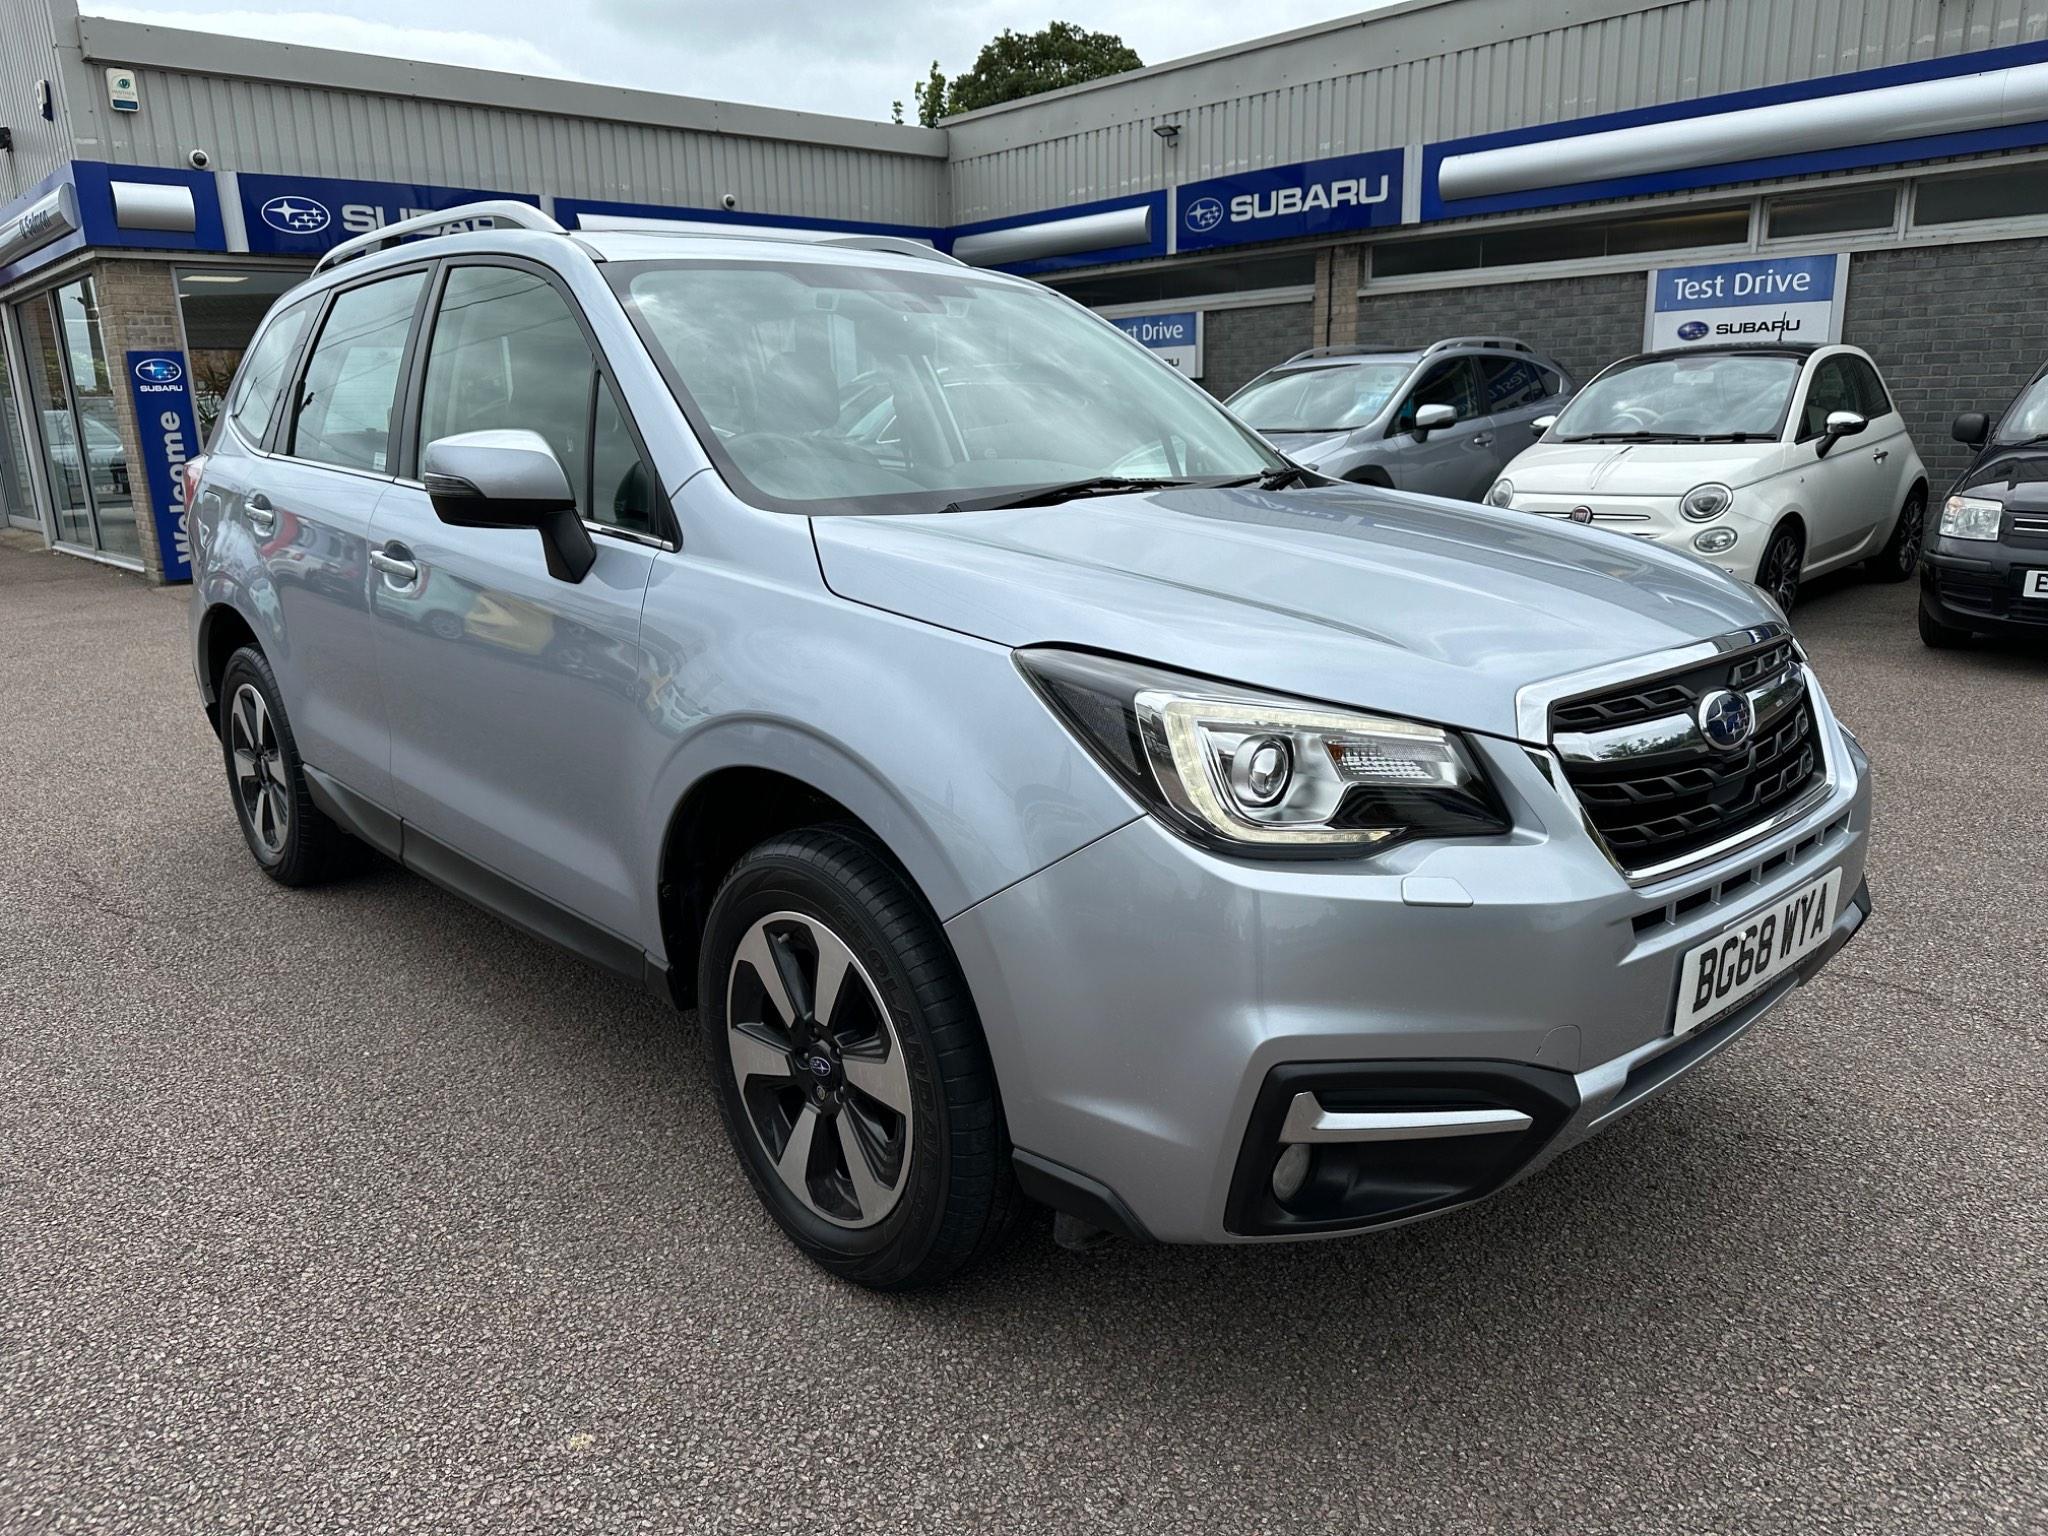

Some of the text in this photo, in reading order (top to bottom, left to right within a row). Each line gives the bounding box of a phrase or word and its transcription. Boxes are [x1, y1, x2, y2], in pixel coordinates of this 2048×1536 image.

[1230, 175, 1389, 222] SUBARU
[1674, 269, 1811, 300] Test Drive
[1142, 321, 1184, 341] Drive
[1716, 319, 1801, 335] SUBARU
[140, 384, 183, 392] SUBARU
[1692, 914, 1776, 1014] BG68
[1779, 882, 1828, 960] WYA
